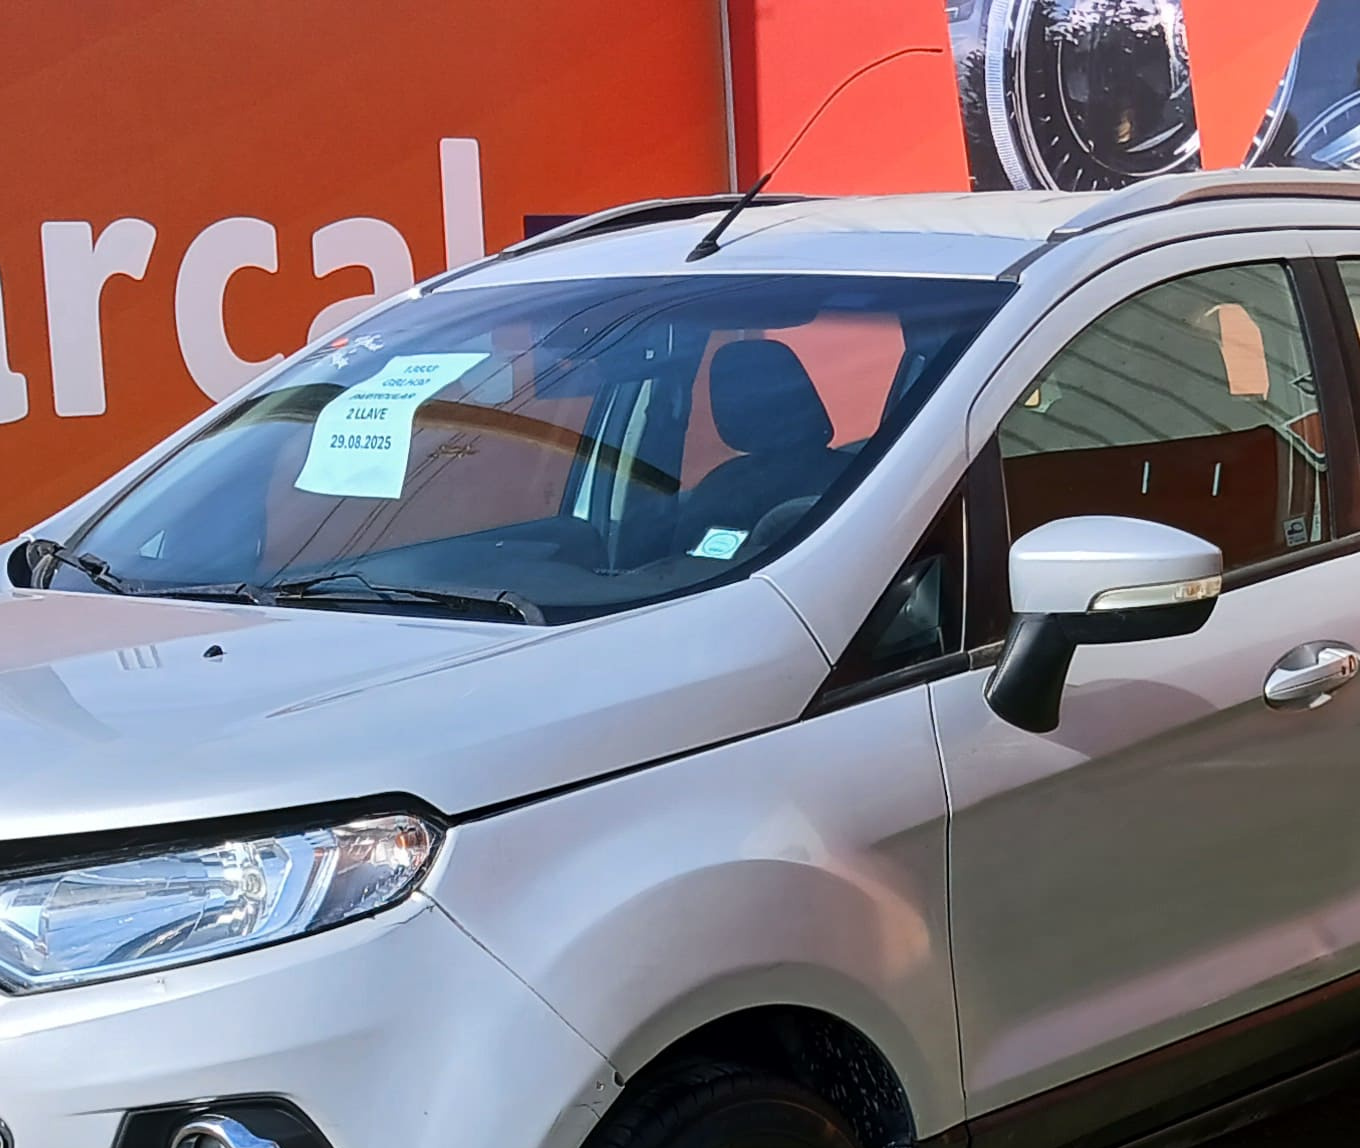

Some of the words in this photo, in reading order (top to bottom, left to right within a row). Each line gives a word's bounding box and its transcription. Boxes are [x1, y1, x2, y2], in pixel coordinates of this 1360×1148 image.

[346, 407, 356, 420] 2
[355, 407, 389, 420] LLAVE
[330, 434, 392, 450] 29.08.2025
